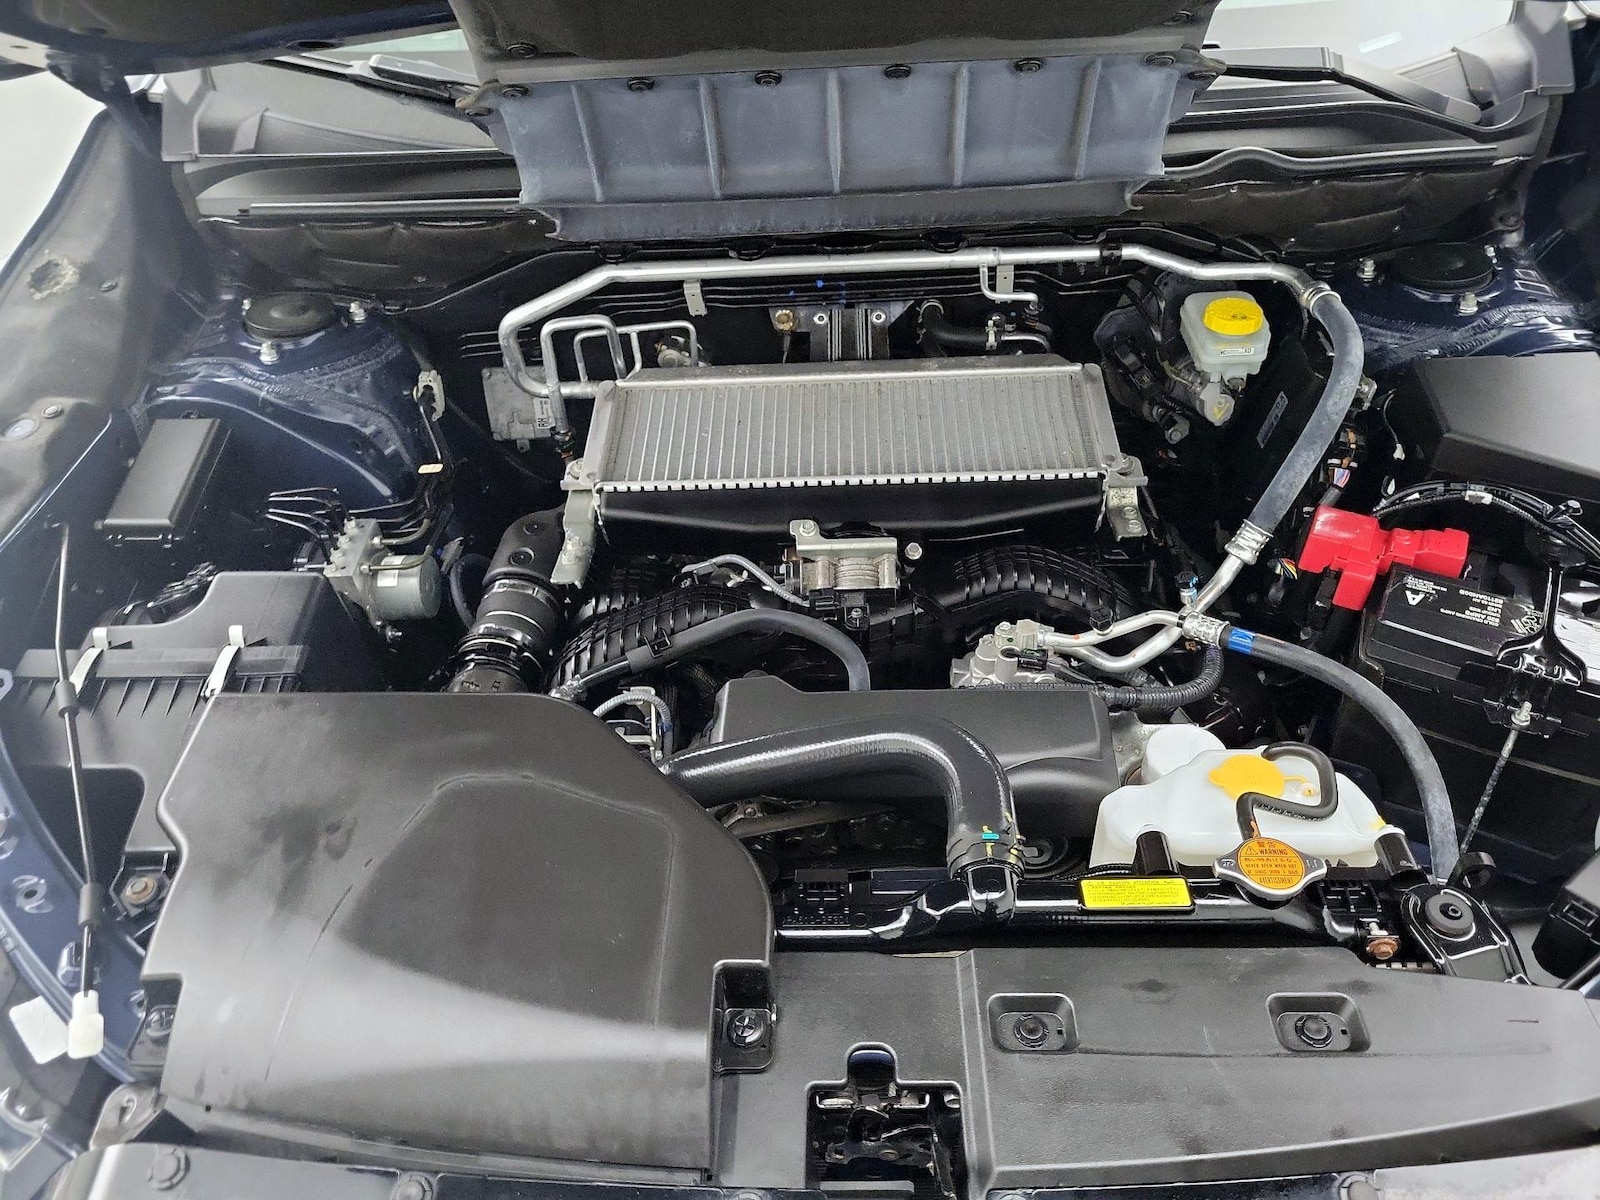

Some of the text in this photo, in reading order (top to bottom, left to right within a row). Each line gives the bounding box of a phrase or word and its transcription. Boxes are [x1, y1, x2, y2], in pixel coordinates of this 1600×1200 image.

[1439, 608, 1499, 627] COLD CRANKING AMPS
[1464, 609, 1486, 619] AMPS
[1481, 609, 1501, 618] GROUP
